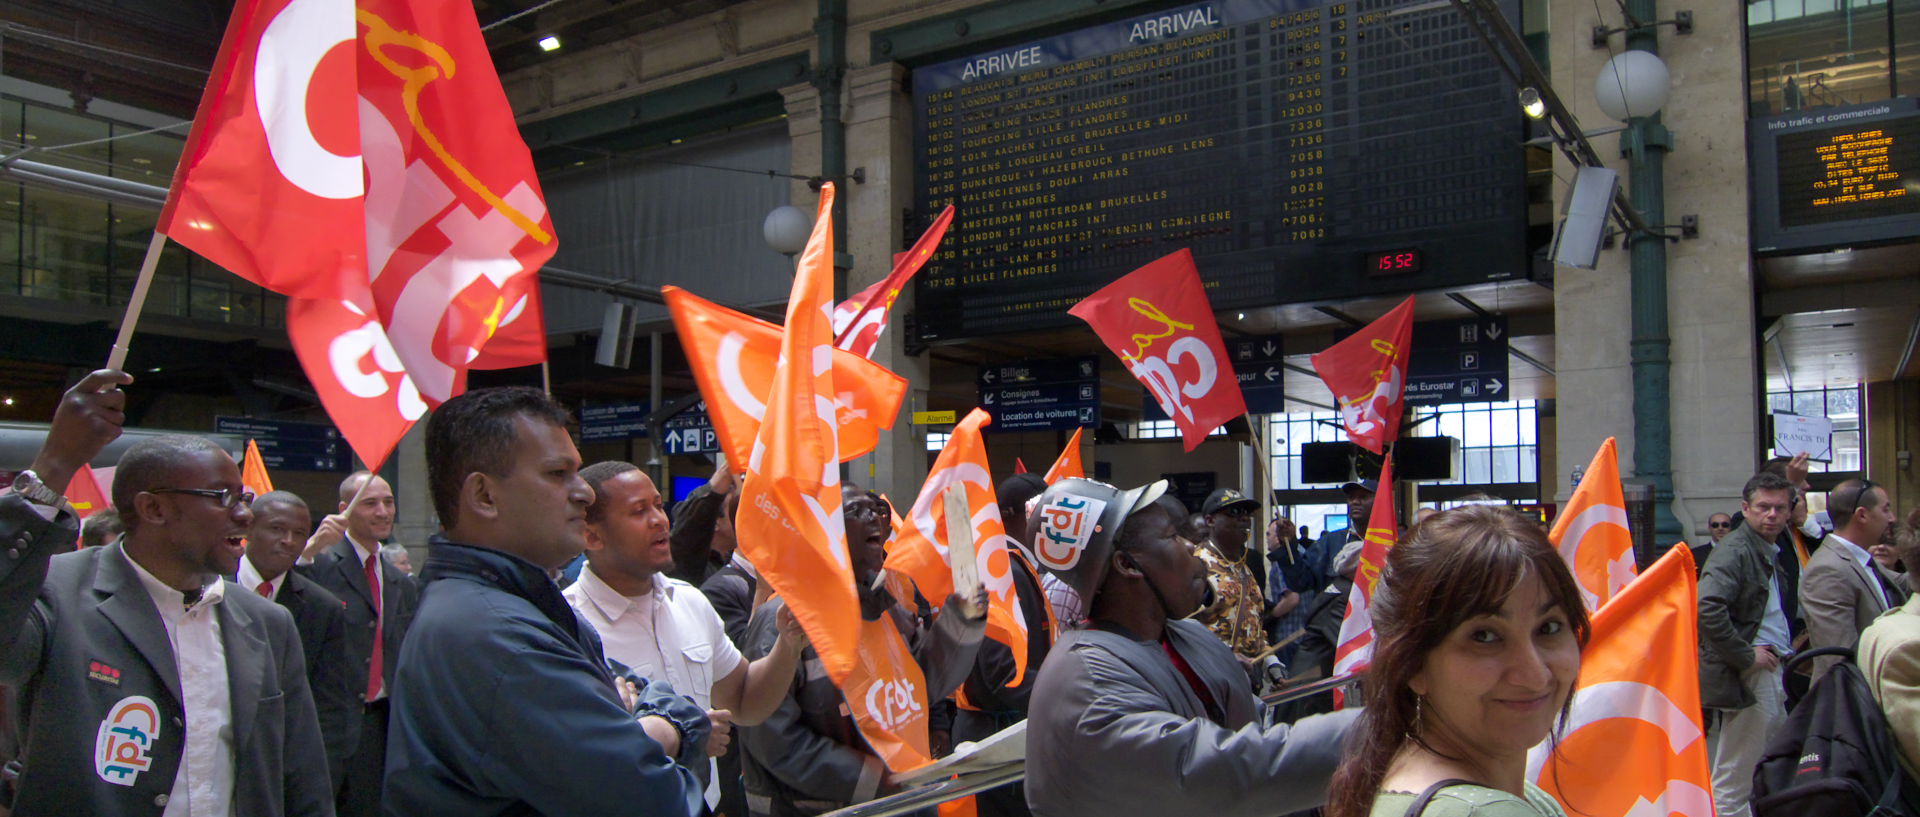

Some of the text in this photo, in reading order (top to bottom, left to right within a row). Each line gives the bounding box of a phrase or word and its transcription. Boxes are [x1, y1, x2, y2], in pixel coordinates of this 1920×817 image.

[1129, 7, 1219, 42] ARRIVAL
[962, 46, 1041, 80] ARRIVEE
[961, 95, 1001, 109] LONDON
[1027, 79, 1077, 95] PANCRAS
[1070, 95, 1128, 113] FLANDRES
[962, 131, 1021, 148] TOURCOING
[1028, 122, 1062, 136] LILLE
[1070, 110, 1128, 129] FLANDRES
[1768, 105, 1890, 131] Info trafic et commerciale
[961, 150, 987, 163] KOLN
[995, 142, 1035, 156] AACHEN
[1041, 133, 1076, 148] LIEGE
[962, 161, 1001, 176] AMIENS
[1008, 150, 1063, 168] LONGUEAU
[1070, 143, 1105, 156] CREIL
[1042, 155, 1114, 175] HAZEBROUCK
[1122, 144, 1175, 161] BETHUNE
[1183, 137, 1216, 151] LENS
[962, 182, 1042, 204] VALENCIENNES
[1049, 175, 1083, 189] DOUAI
[1093, 167, 1129, 182] ARRAS
[962, 203, 995, 217] LILLE
[1001, 193, 1057, 210] FLANDRES
[962, 212, 1023, 230] AMSTERDAM
[1029, 201, 1093, 220] ROTTERDAM
[1100, 190, 1168, 209] BRUXELLES
[962, 230, 1002, 244] LONDON
[1009, 226, 1022, 237] ST
[1029, 217, 1078, 233] PANCRAS
[1087, 213, 1107, 225] INT
[963, 271, 996, 284] LILLE
[1003, 263, 1057, 280] FLANDRES
[1000, 368, 1029, 378] Billets
[1420, 381, 1455, 391] Eurostar
[1001, 389, 1040, 400] Consignes
[926, 414, 953, 423] Alarme
[1001, 408, 1077, 421] Location de voitures
[1778, 432, 1813, 443] FRANCIS
